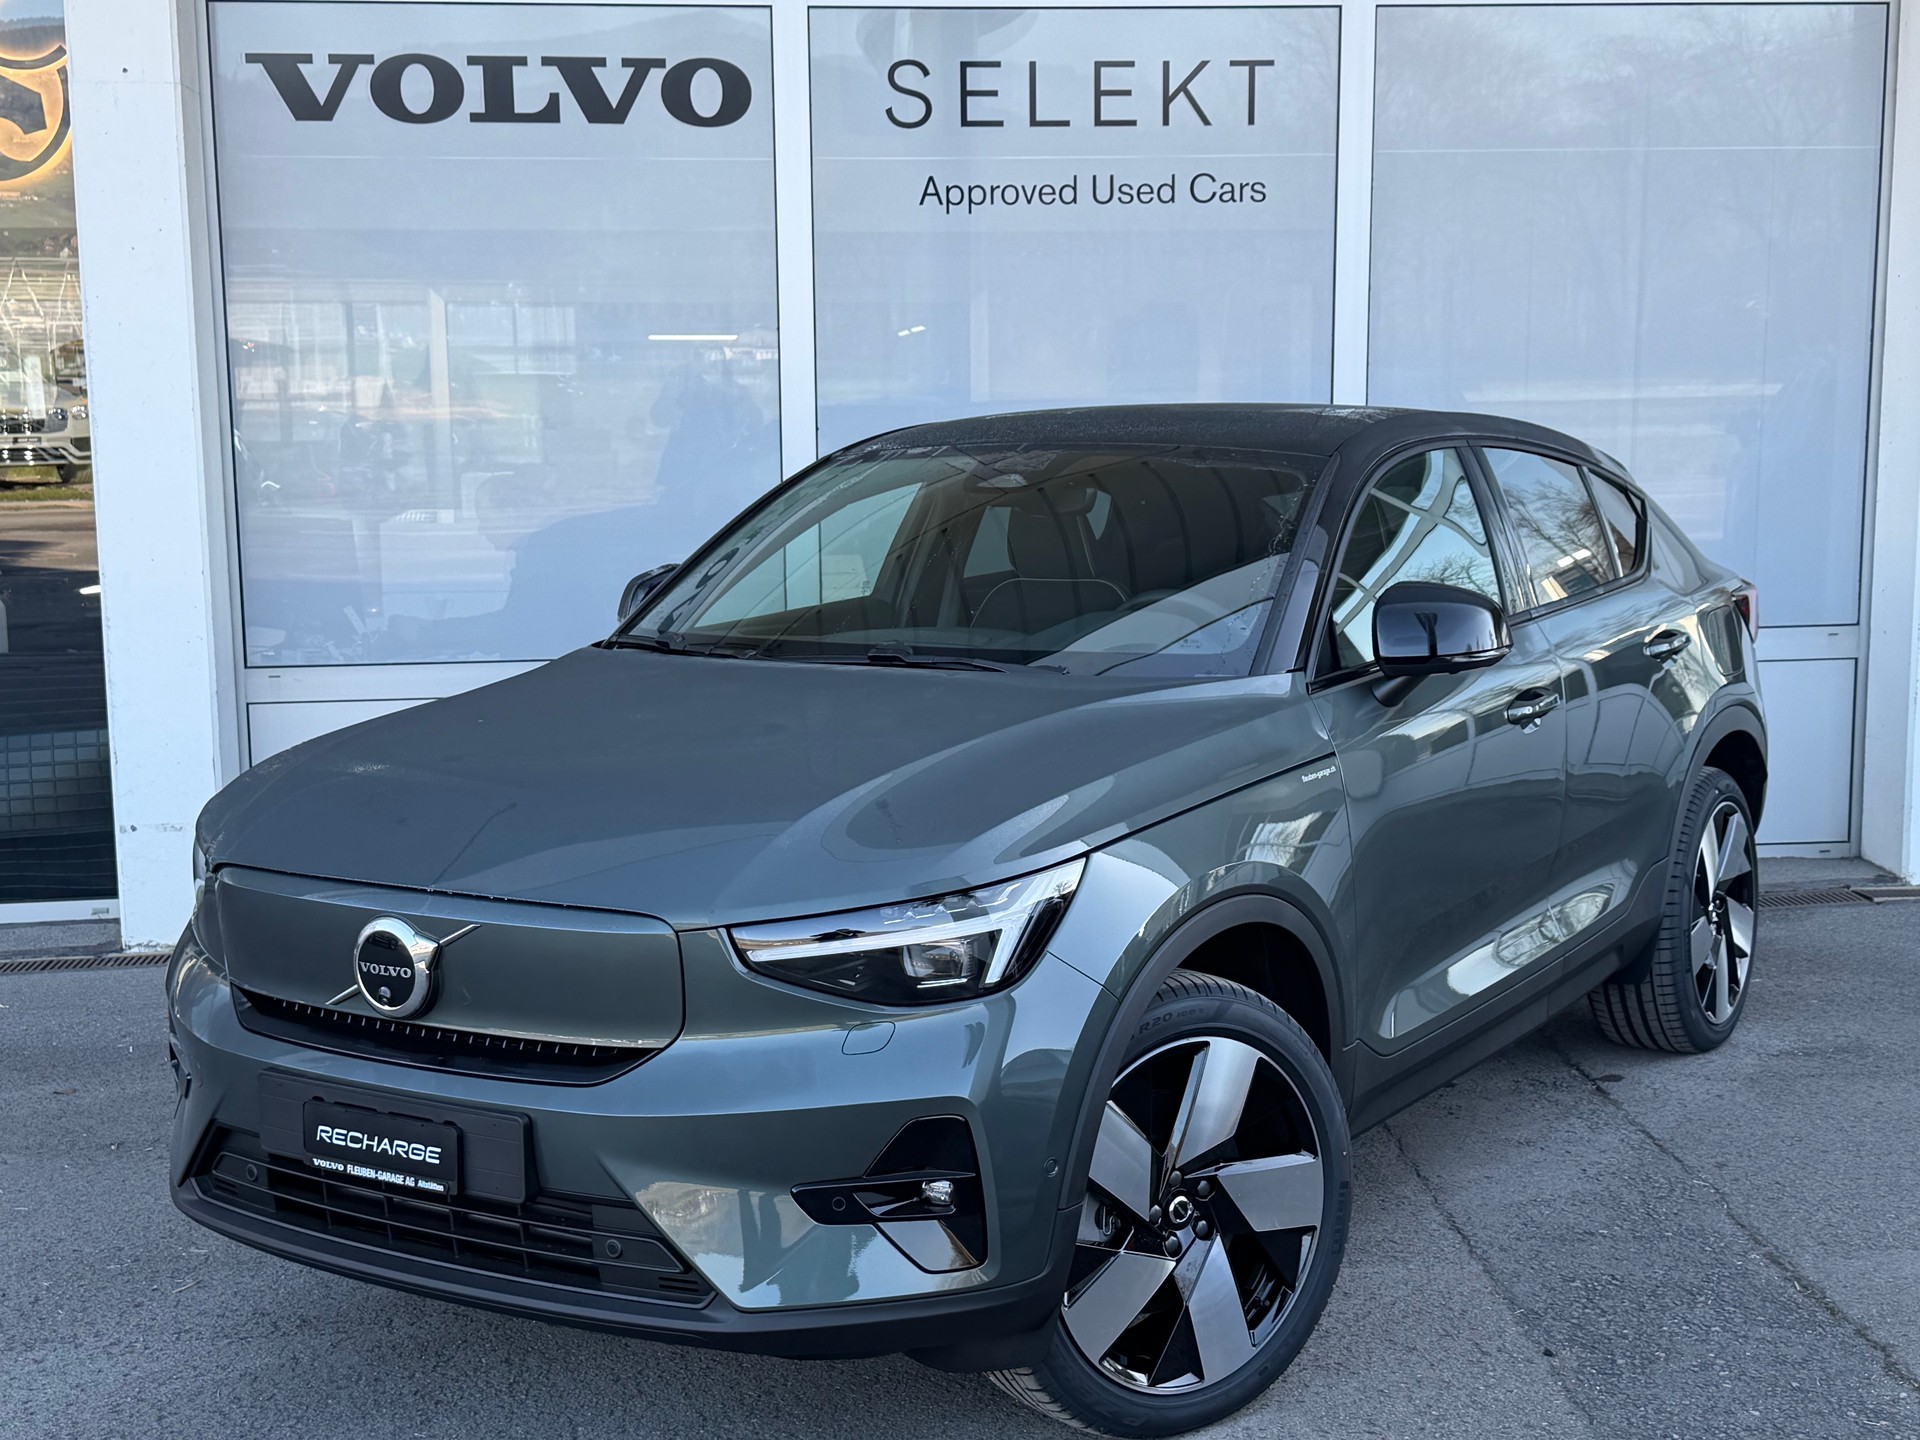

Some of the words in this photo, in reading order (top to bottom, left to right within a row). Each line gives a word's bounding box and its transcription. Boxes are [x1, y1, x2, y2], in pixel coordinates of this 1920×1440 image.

[244, 52, 752, 127] VOLVO
[885, 59, 1275, 129] SELEKT
[918, 174, 1078, 215] Approved
[1092, 173, 1176, 205] Used
[1189, 172, 1267, 204] Cars
[359, 961, 412, 979] VOLVO
[316, 1125, 442, 1165] RECHARGE
[312, 1157, 345, 1171] VOLVO
[404, 1175, 416, 1187] AG
